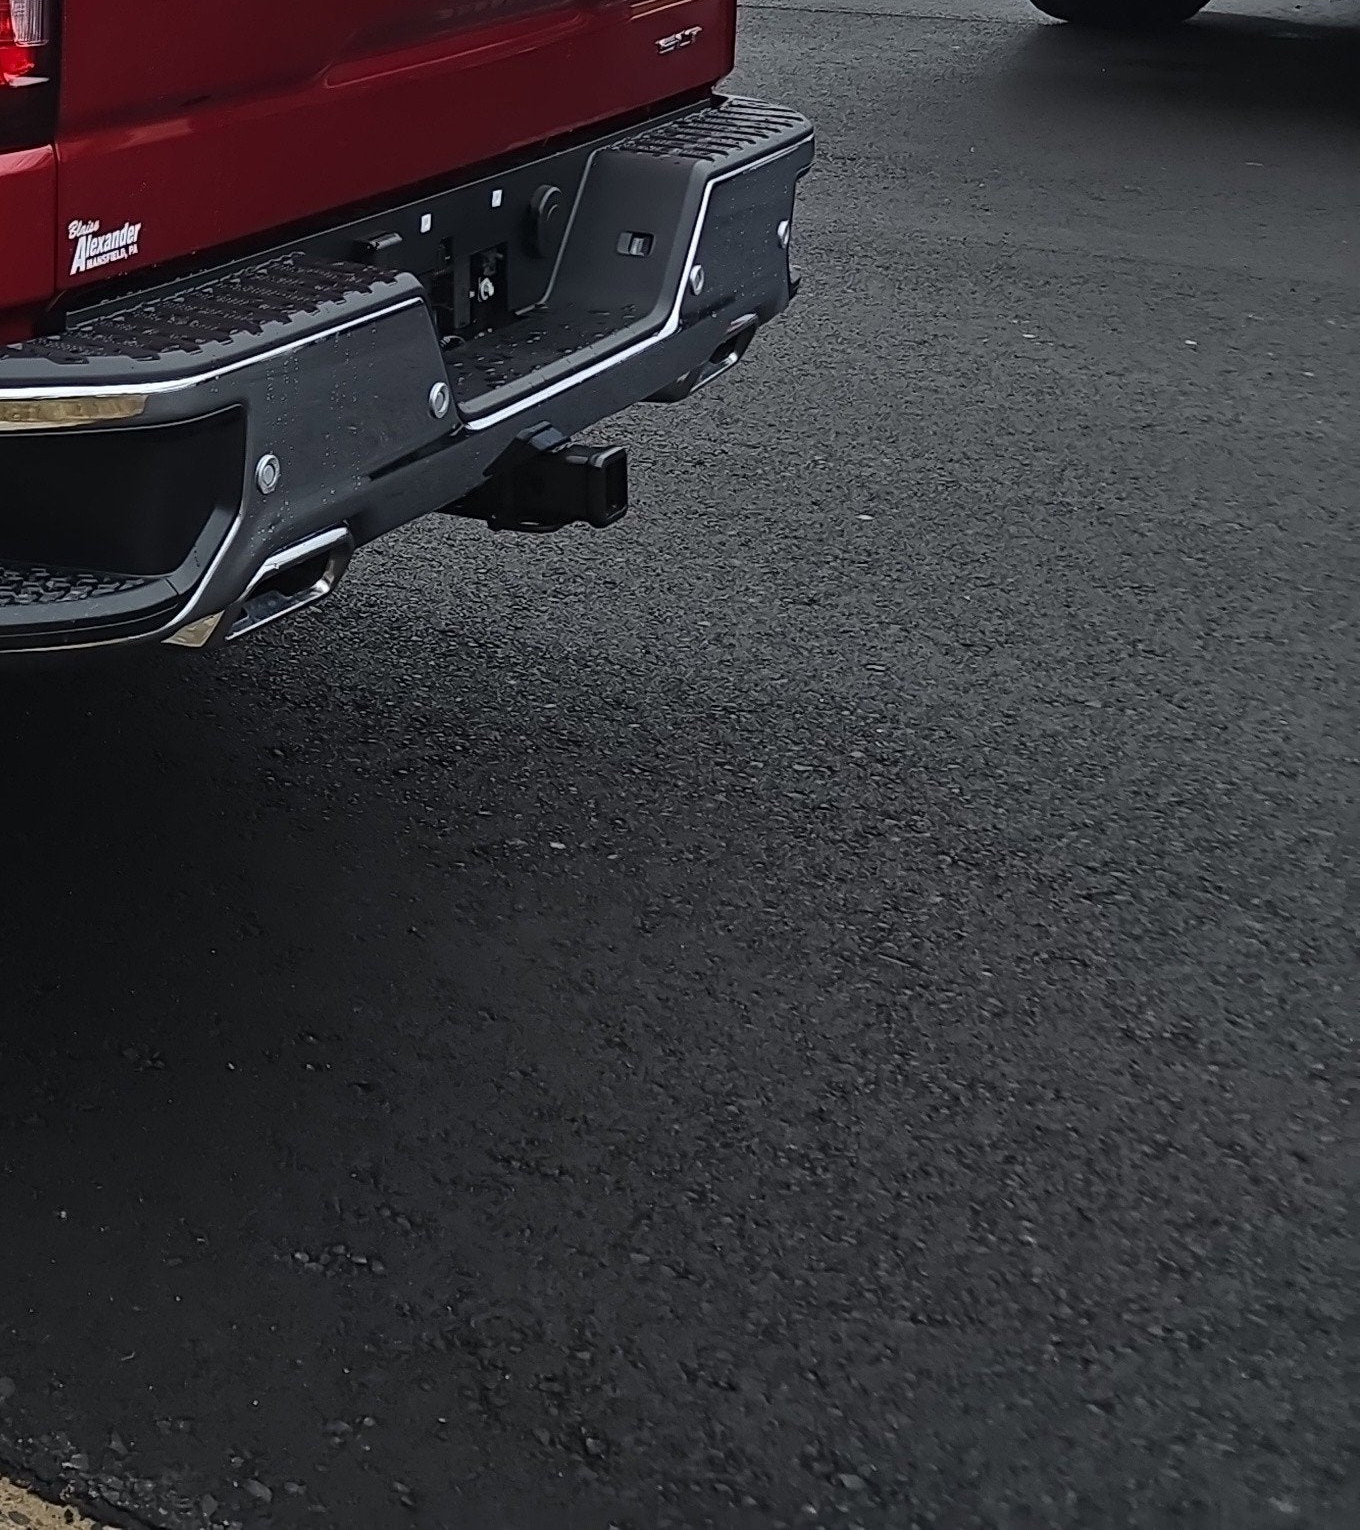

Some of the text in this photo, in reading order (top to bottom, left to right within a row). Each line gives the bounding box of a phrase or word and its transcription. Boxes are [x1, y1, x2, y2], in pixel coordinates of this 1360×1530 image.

[654, 25, 703, 55] SLT
[69, 222, 141, 276] Alexander
[128, 243, 139, 256] PA
